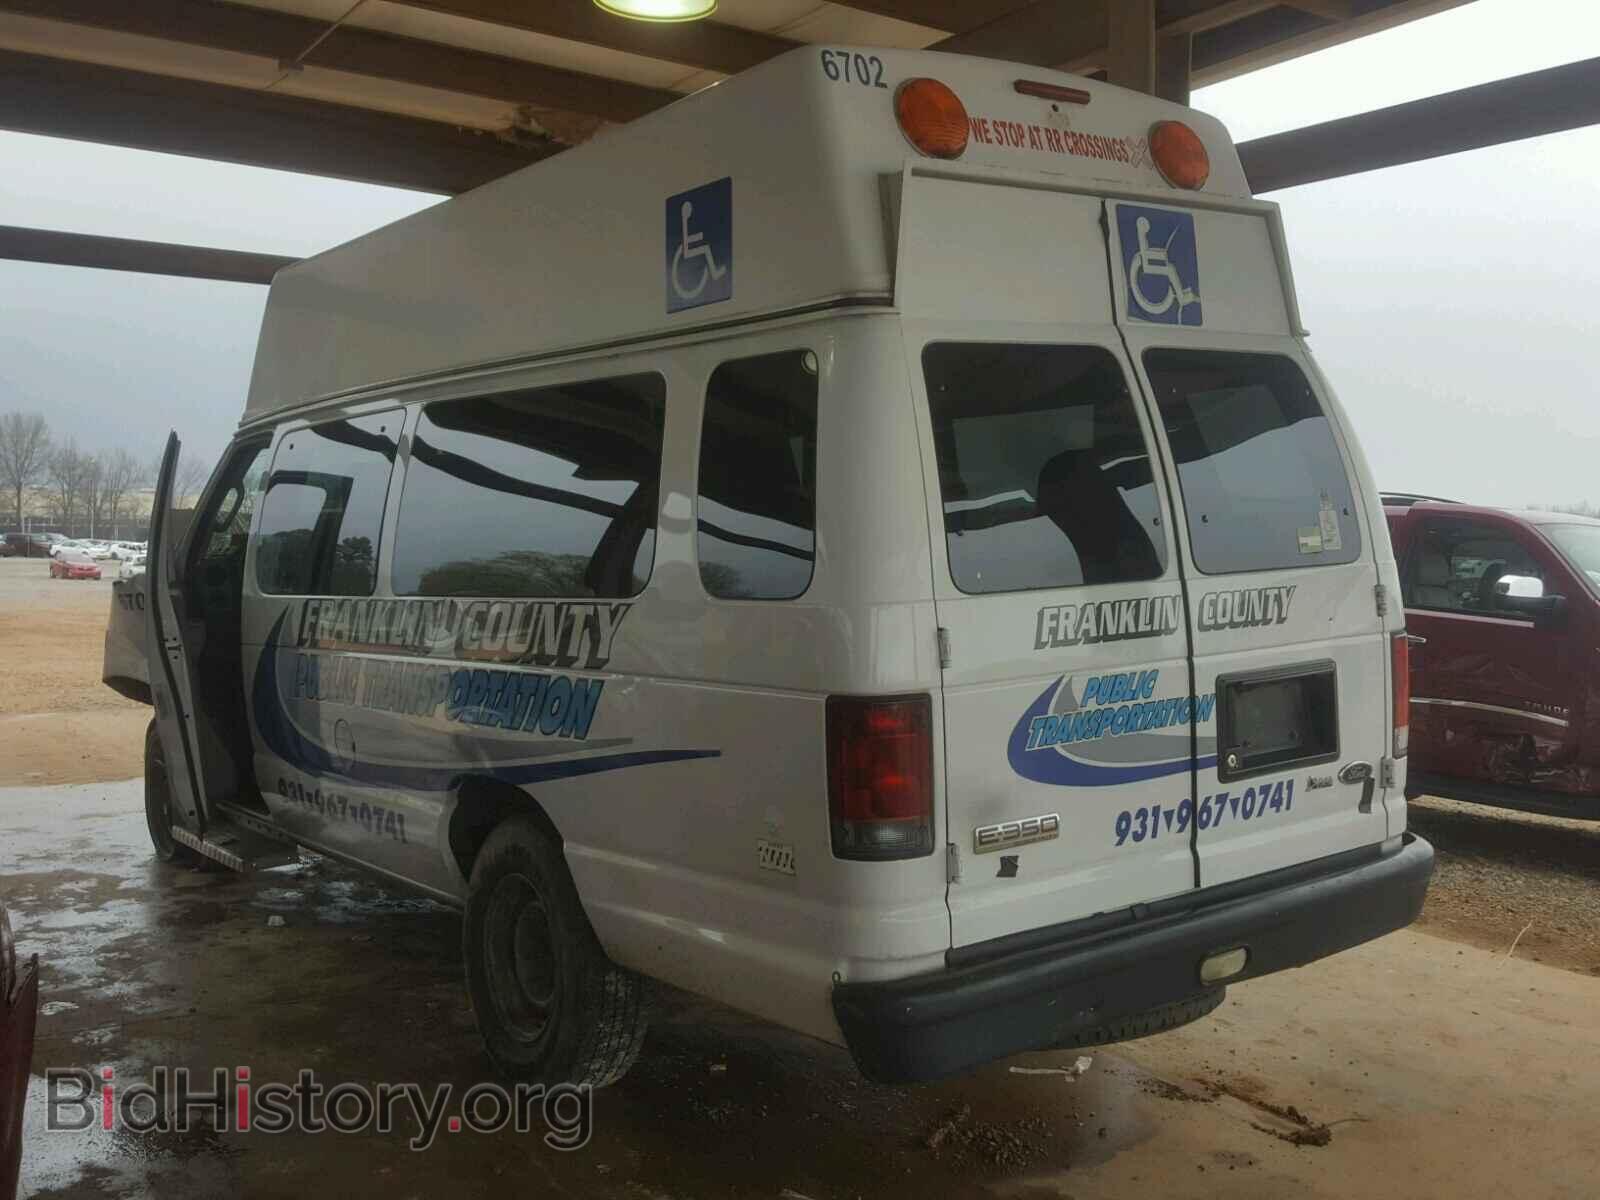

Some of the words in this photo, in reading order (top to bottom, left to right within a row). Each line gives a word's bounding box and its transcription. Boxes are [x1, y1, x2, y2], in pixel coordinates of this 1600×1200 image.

[821, 49, 888, 88] 6702
[970, 117, 993, 145] WE
[992, 120, 1025, 148] STOP
[1028, 125, 1044, 151] AT
[1043, 127, 1065, 154] RR
[1063, 130, 1130, 164] CROSSINGS
[298, 598, 460, 654] FRANKLIN
[455, 600, 633, 669] COUNTY
[1034, 594, 1181, 650] FRANKLIN
[1197, 585, 1297, 632] COUNTY
[1080, 669, 1159, 708] PUBLIC
[1026, 693, 1217, 749] TRANSPORTATION
